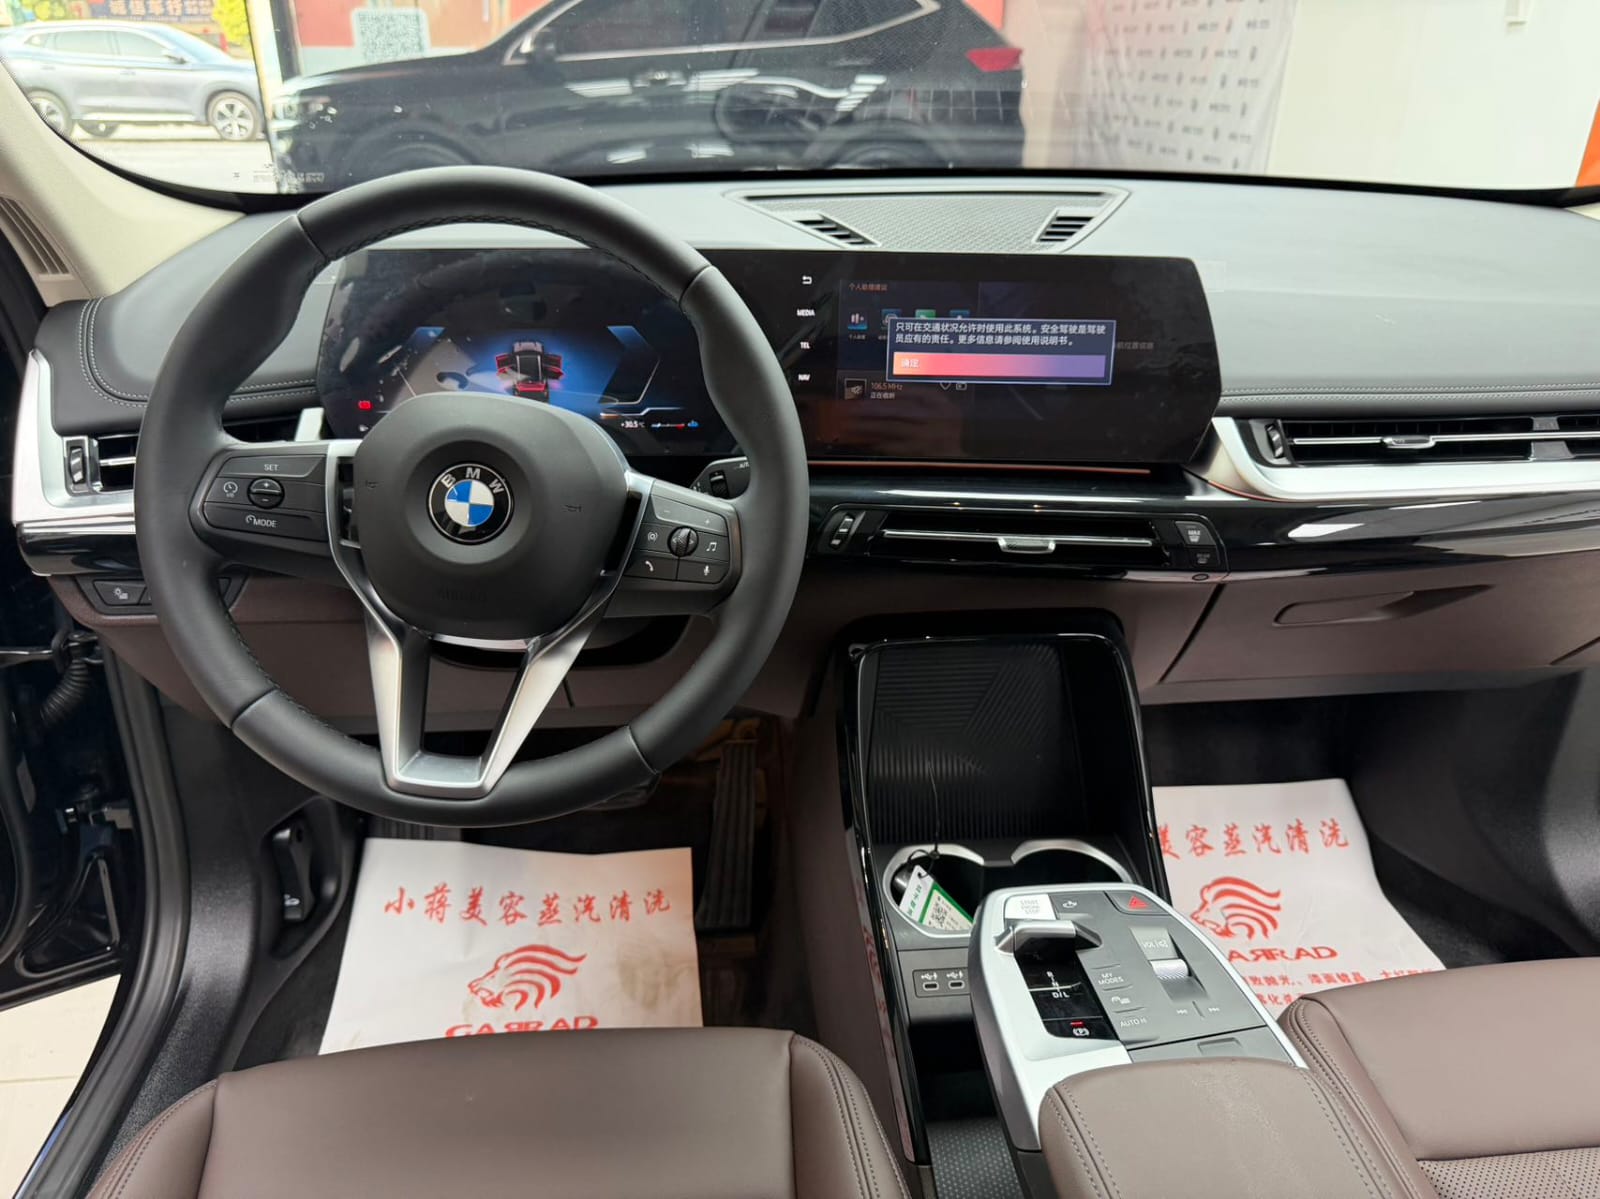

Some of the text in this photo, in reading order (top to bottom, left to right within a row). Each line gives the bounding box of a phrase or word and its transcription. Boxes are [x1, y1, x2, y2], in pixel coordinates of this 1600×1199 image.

[441, 467, 504, 494] BMW
[253, 519, 277, 528] MODE
[384, 881, 672, 927] 小蒋美容蒸汽清洗
